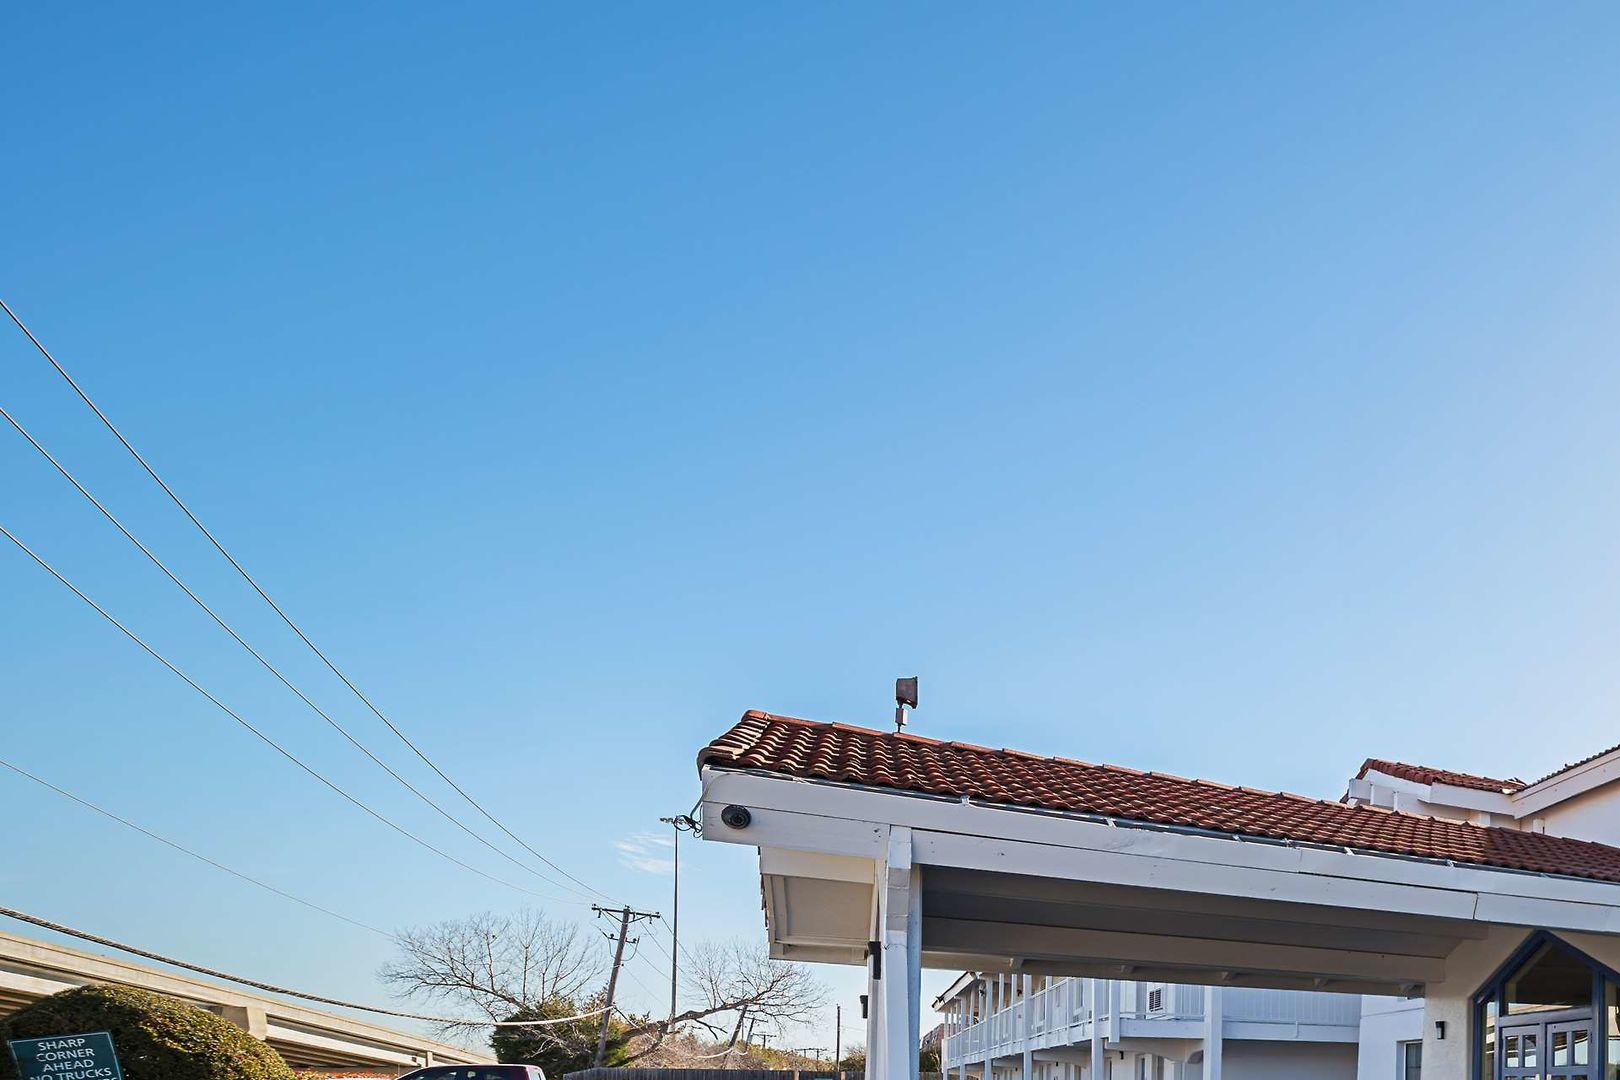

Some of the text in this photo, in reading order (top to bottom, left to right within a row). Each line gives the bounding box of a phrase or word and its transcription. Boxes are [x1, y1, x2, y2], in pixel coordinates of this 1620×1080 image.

[37, 1038, 85, 1051] SHARP
[36, 1048, 95, 1062] CORNER
[43, 1059, 94, 1072] AHEAD
[56, 1067, 112, 1080] TRUCKS
